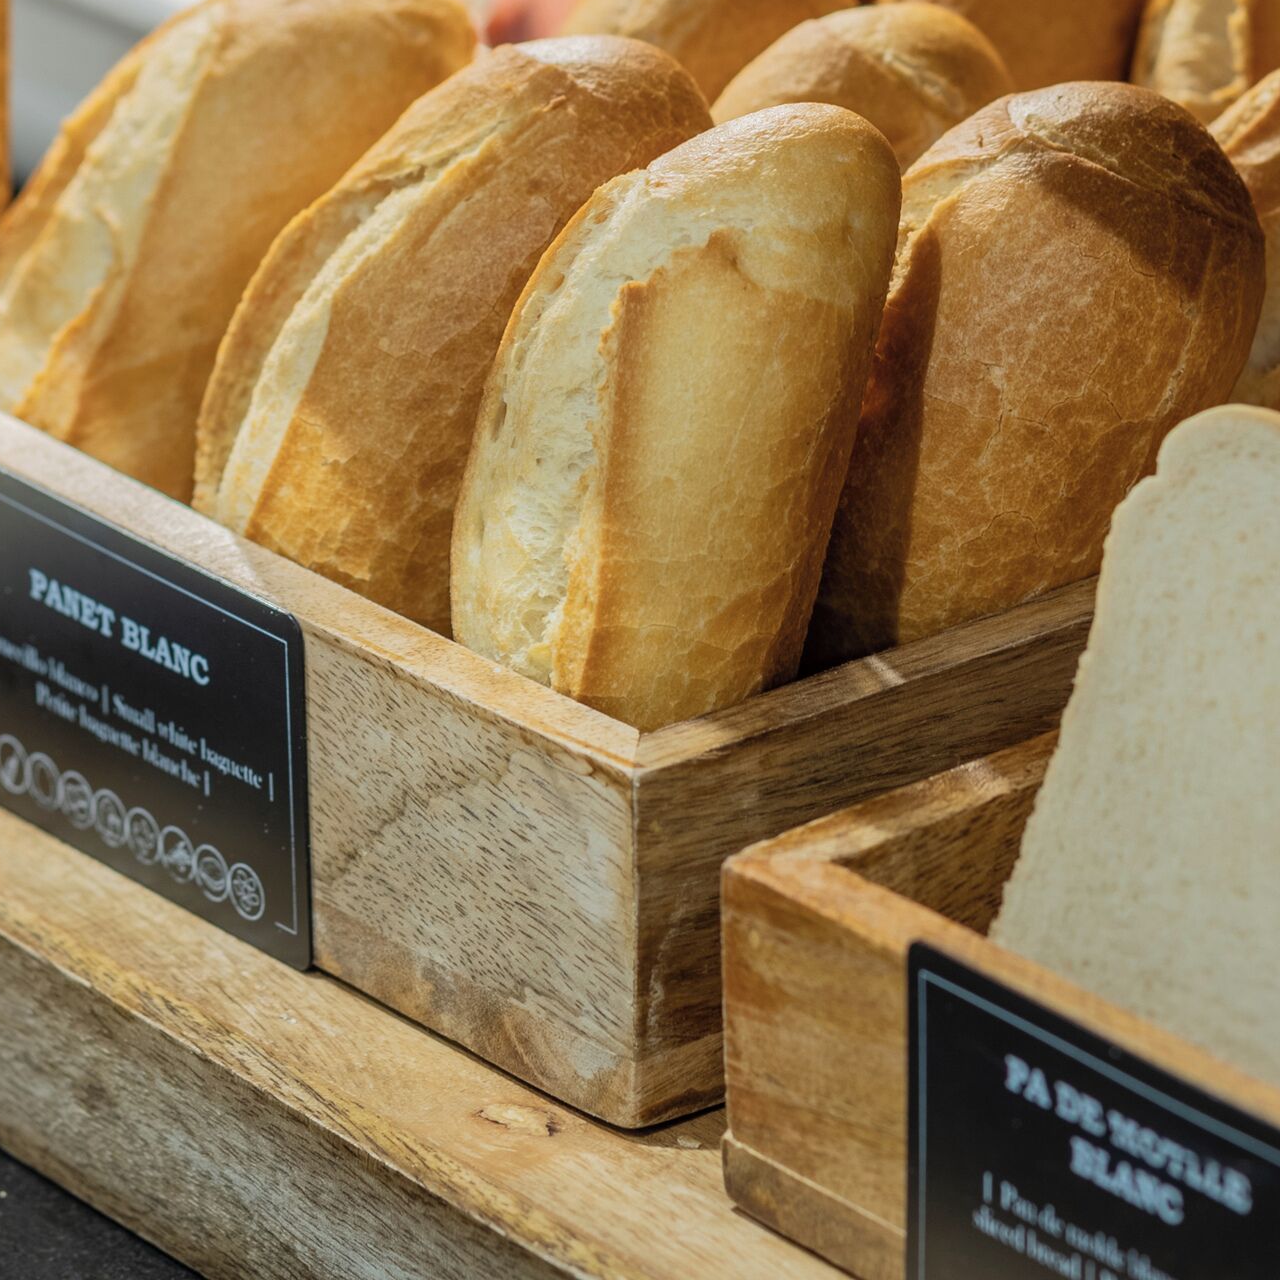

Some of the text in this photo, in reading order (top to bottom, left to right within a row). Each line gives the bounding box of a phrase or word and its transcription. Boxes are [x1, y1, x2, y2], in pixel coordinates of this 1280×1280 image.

[29, 567, 211, 687] PANET BLANC
[35, 681, 77, 723] Petite
[79, 703, 141, 756] baguette
[142, 738, 201, 788] blanche
[113, 693, 156, 734] Small
[157, 721, 198, 755] white
[199, 737, 263, 789] baguette
[1005, 1053, 1052, 1109] PA
[1054, 1080, 1107, 1137] DE
[1070, 1134, 1184, 1226] BLANC
